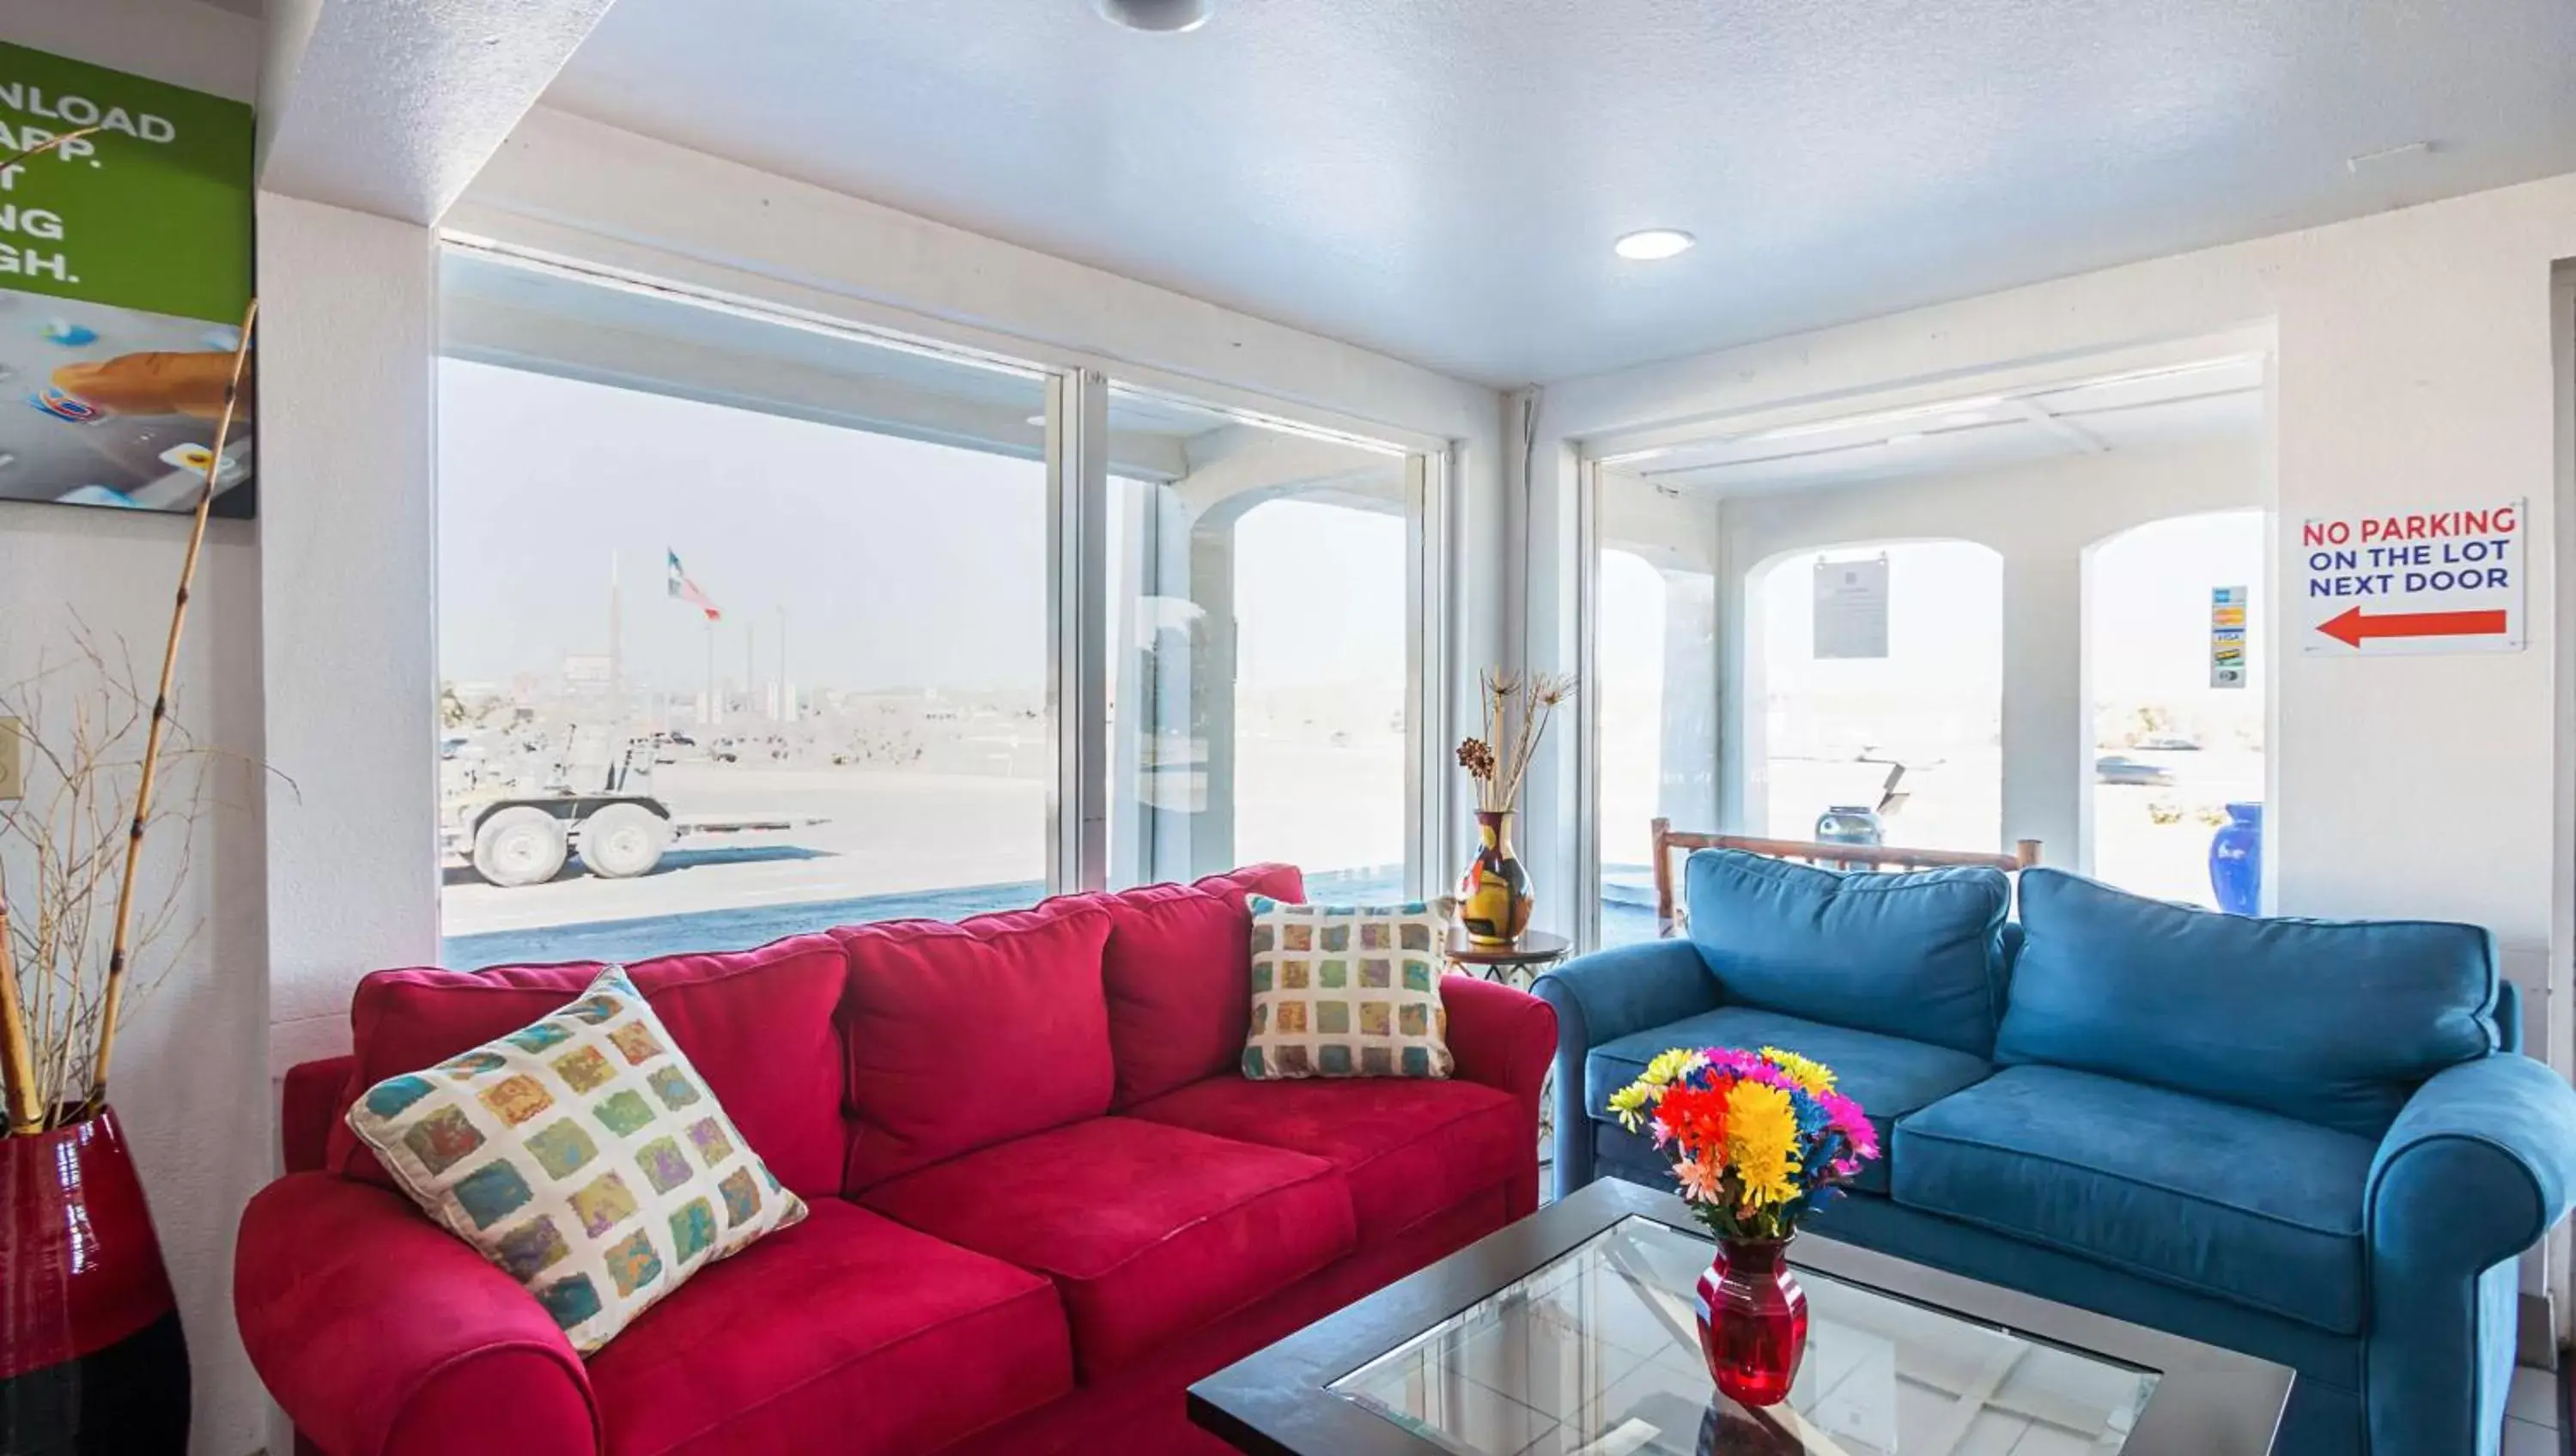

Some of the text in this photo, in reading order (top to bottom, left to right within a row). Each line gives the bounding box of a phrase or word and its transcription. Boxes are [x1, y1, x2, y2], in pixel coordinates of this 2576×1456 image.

[2303, 507, 2516, 547] NO PARKING
[2309, 539, 2510, 571] ON THE LOT
[2310, 567, 2509, 598] NEXT DOOR
